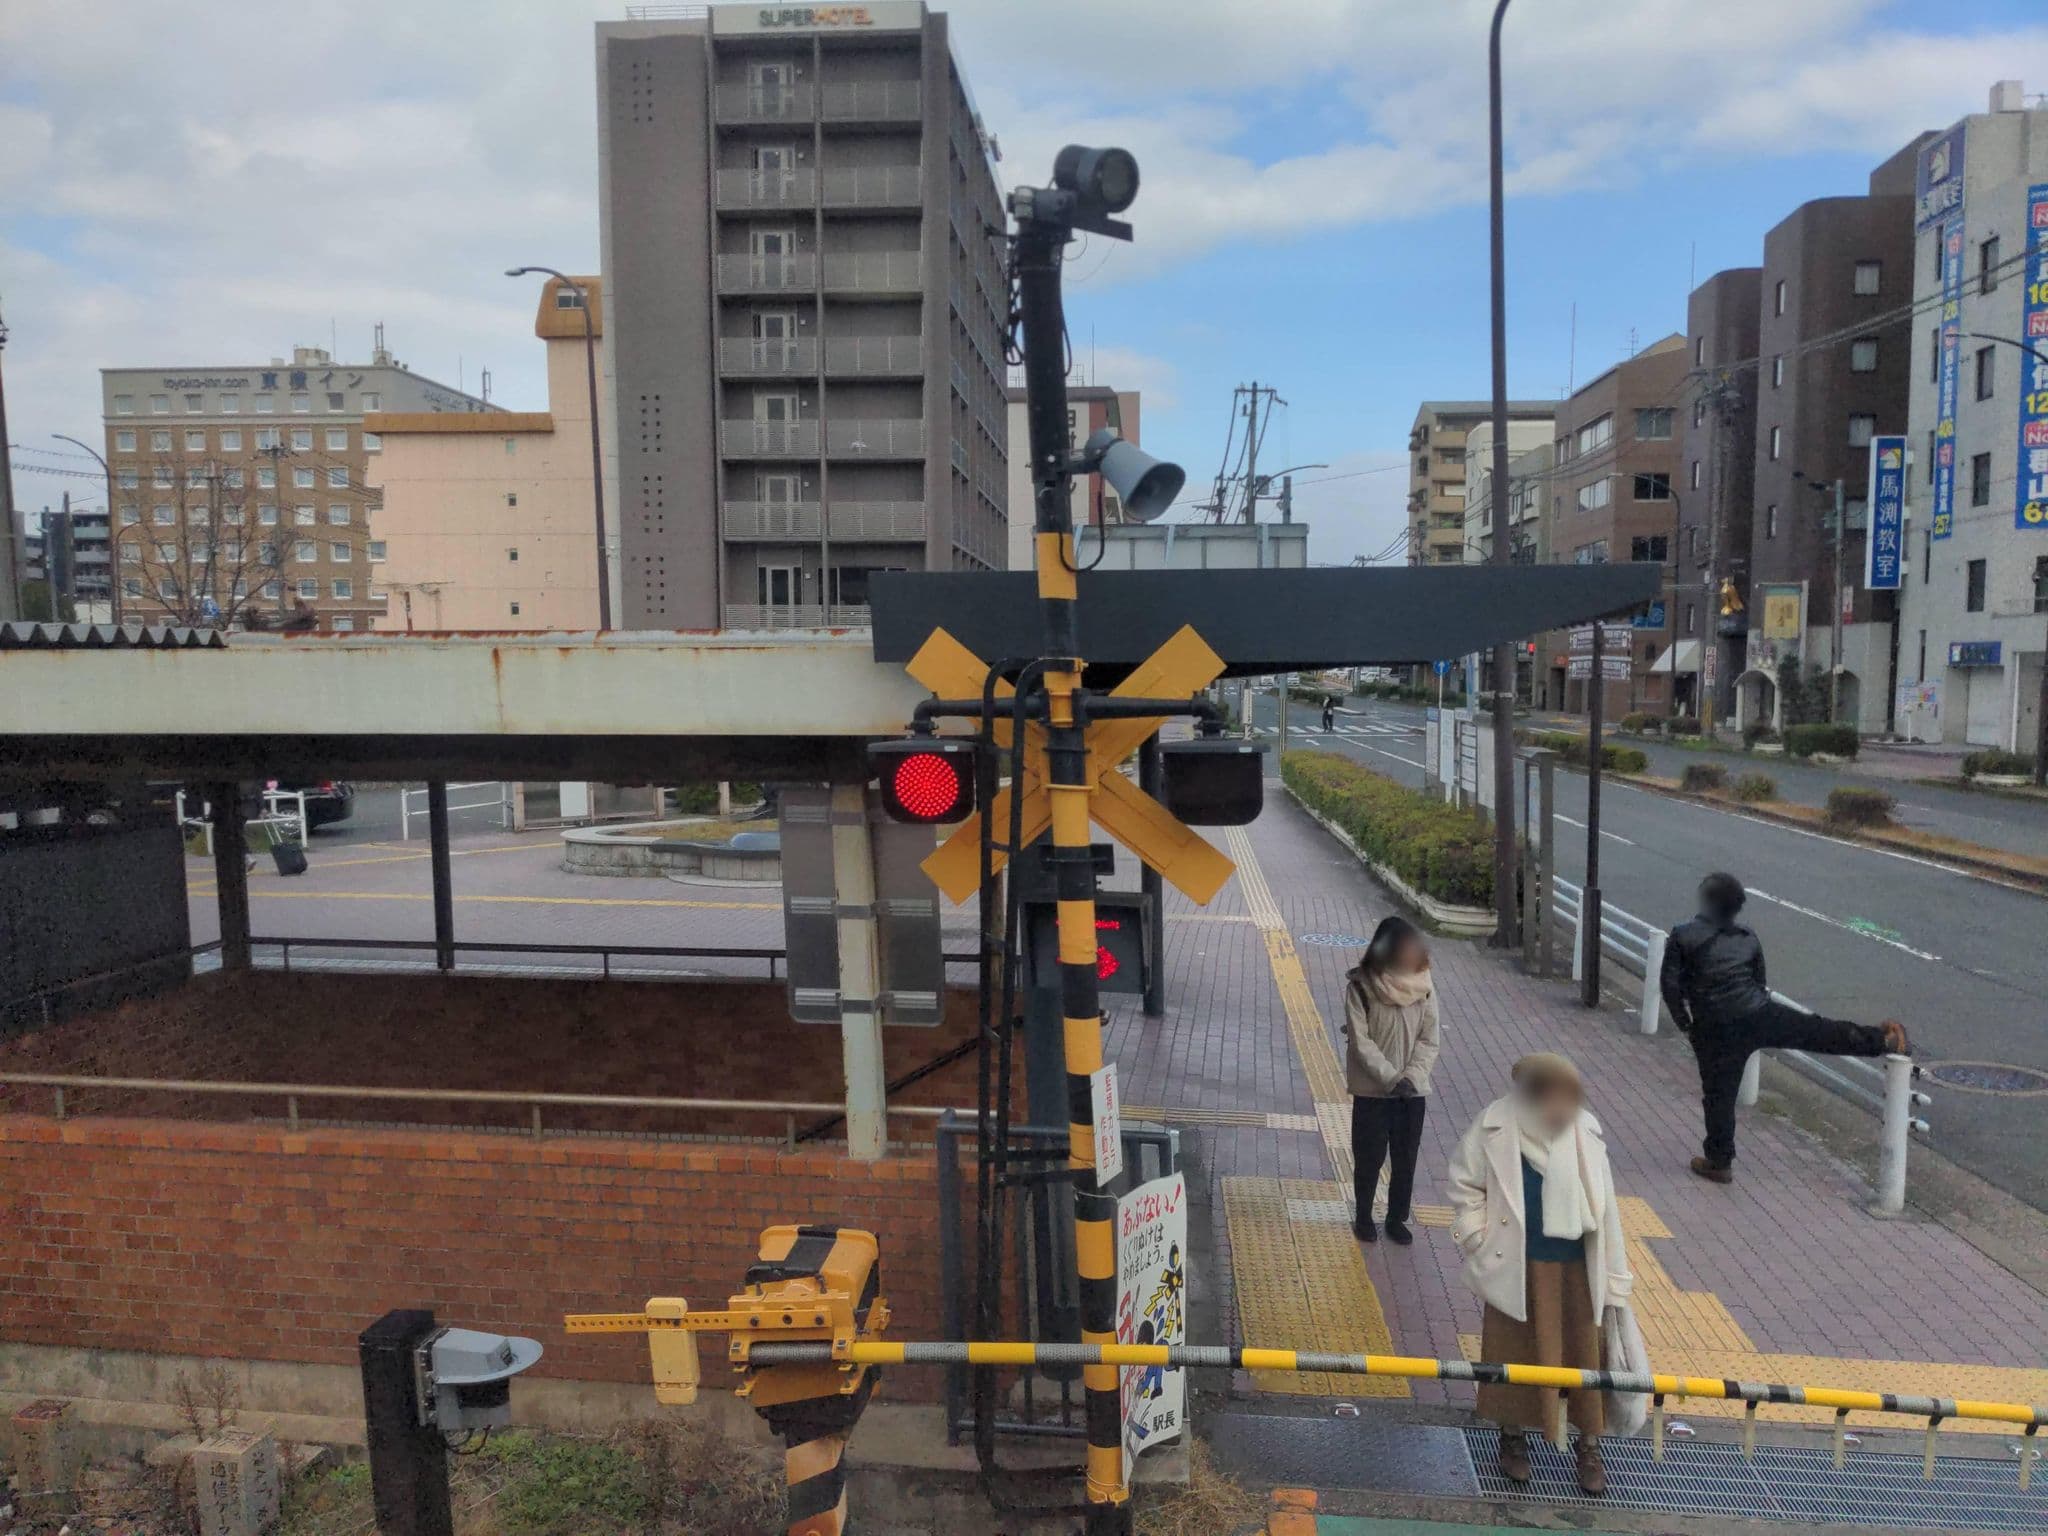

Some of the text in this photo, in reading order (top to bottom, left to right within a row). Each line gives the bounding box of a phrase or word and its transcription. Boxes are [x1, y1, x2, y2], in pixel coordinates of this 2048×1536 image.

[1877, 474, 1898, 579] 馬渕教室
[1100, 1115, 1109, 1173] 作動中
[1153, 1411, 1175, 1433] 駅長
